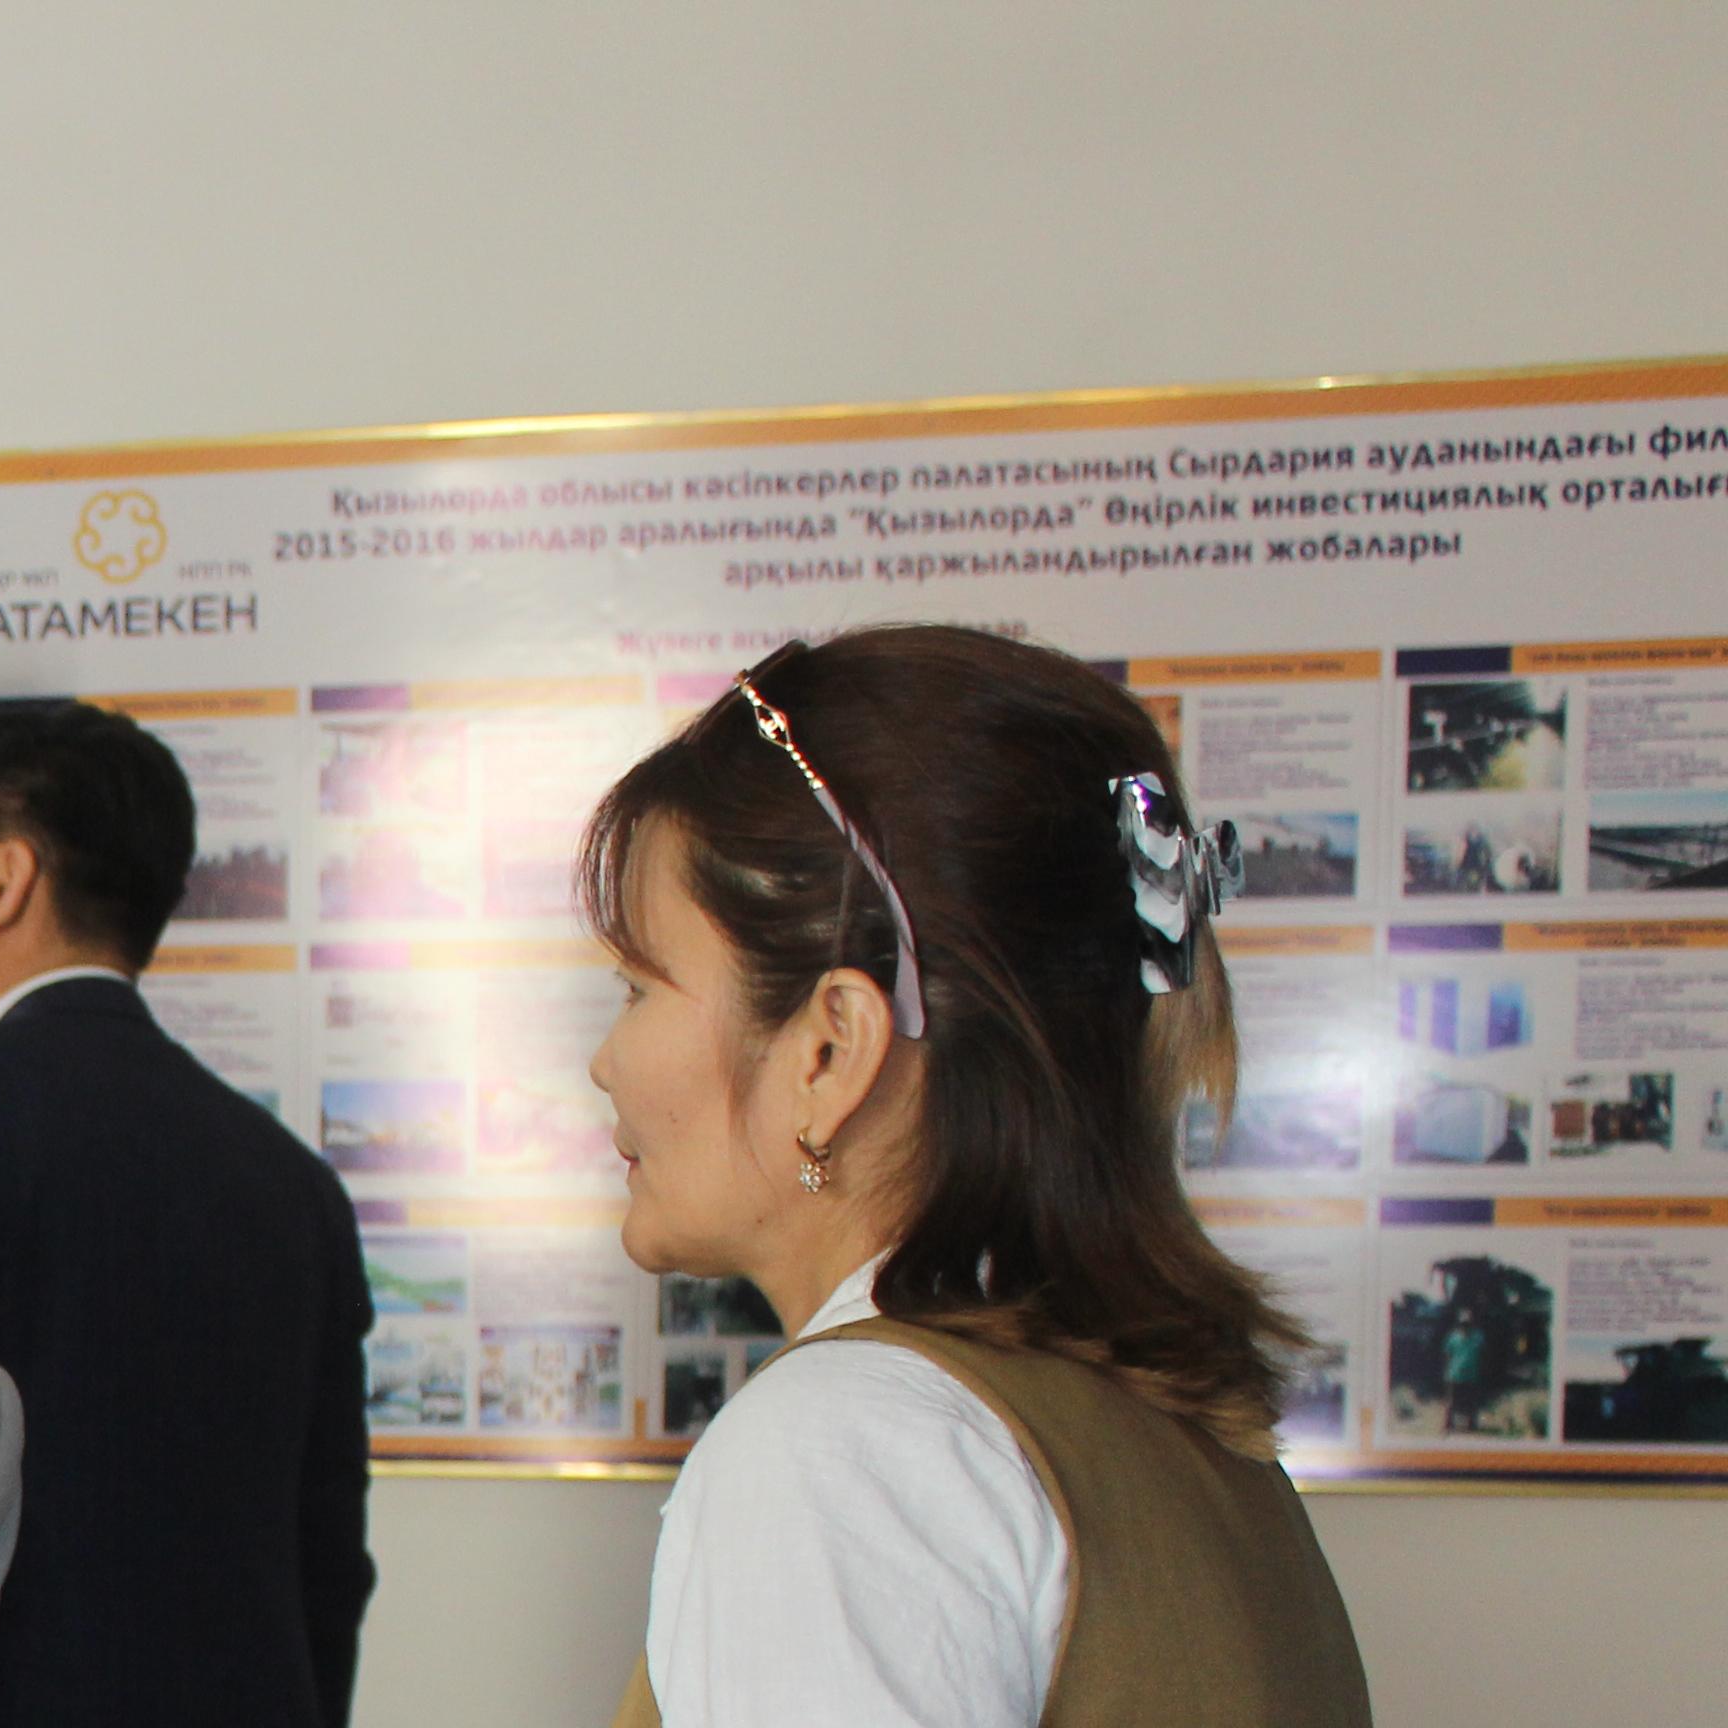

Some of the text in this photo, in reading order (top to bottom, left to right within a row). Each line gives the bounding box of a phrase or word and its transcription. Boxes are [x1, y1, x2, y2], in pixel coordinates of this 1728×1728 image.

[274, 526, 454, 561] 2015-2016
[467, 523, 608, 552] жылдар
[617, 513, 837, 552] аралығында
[1104, 494, 1238, 528] Өңірлік
[1250, 483, 1548, 518] инвестициялық
[1561, 473, 1728, 511] орталығ
[330, 484, 529, 520] Қызылорда
[539, 480, 674, 508] облысы
[684, 466, 899, 501] кәсіпкерлер
[910, 455, 1158, 491] палатасының
[1169, 446, 1355, 480] Сырдария
[1366, 431, 1636, 474] ауданындағы
[724, 531, 1462, 591] арқылы қаржыландырылған жобалары
